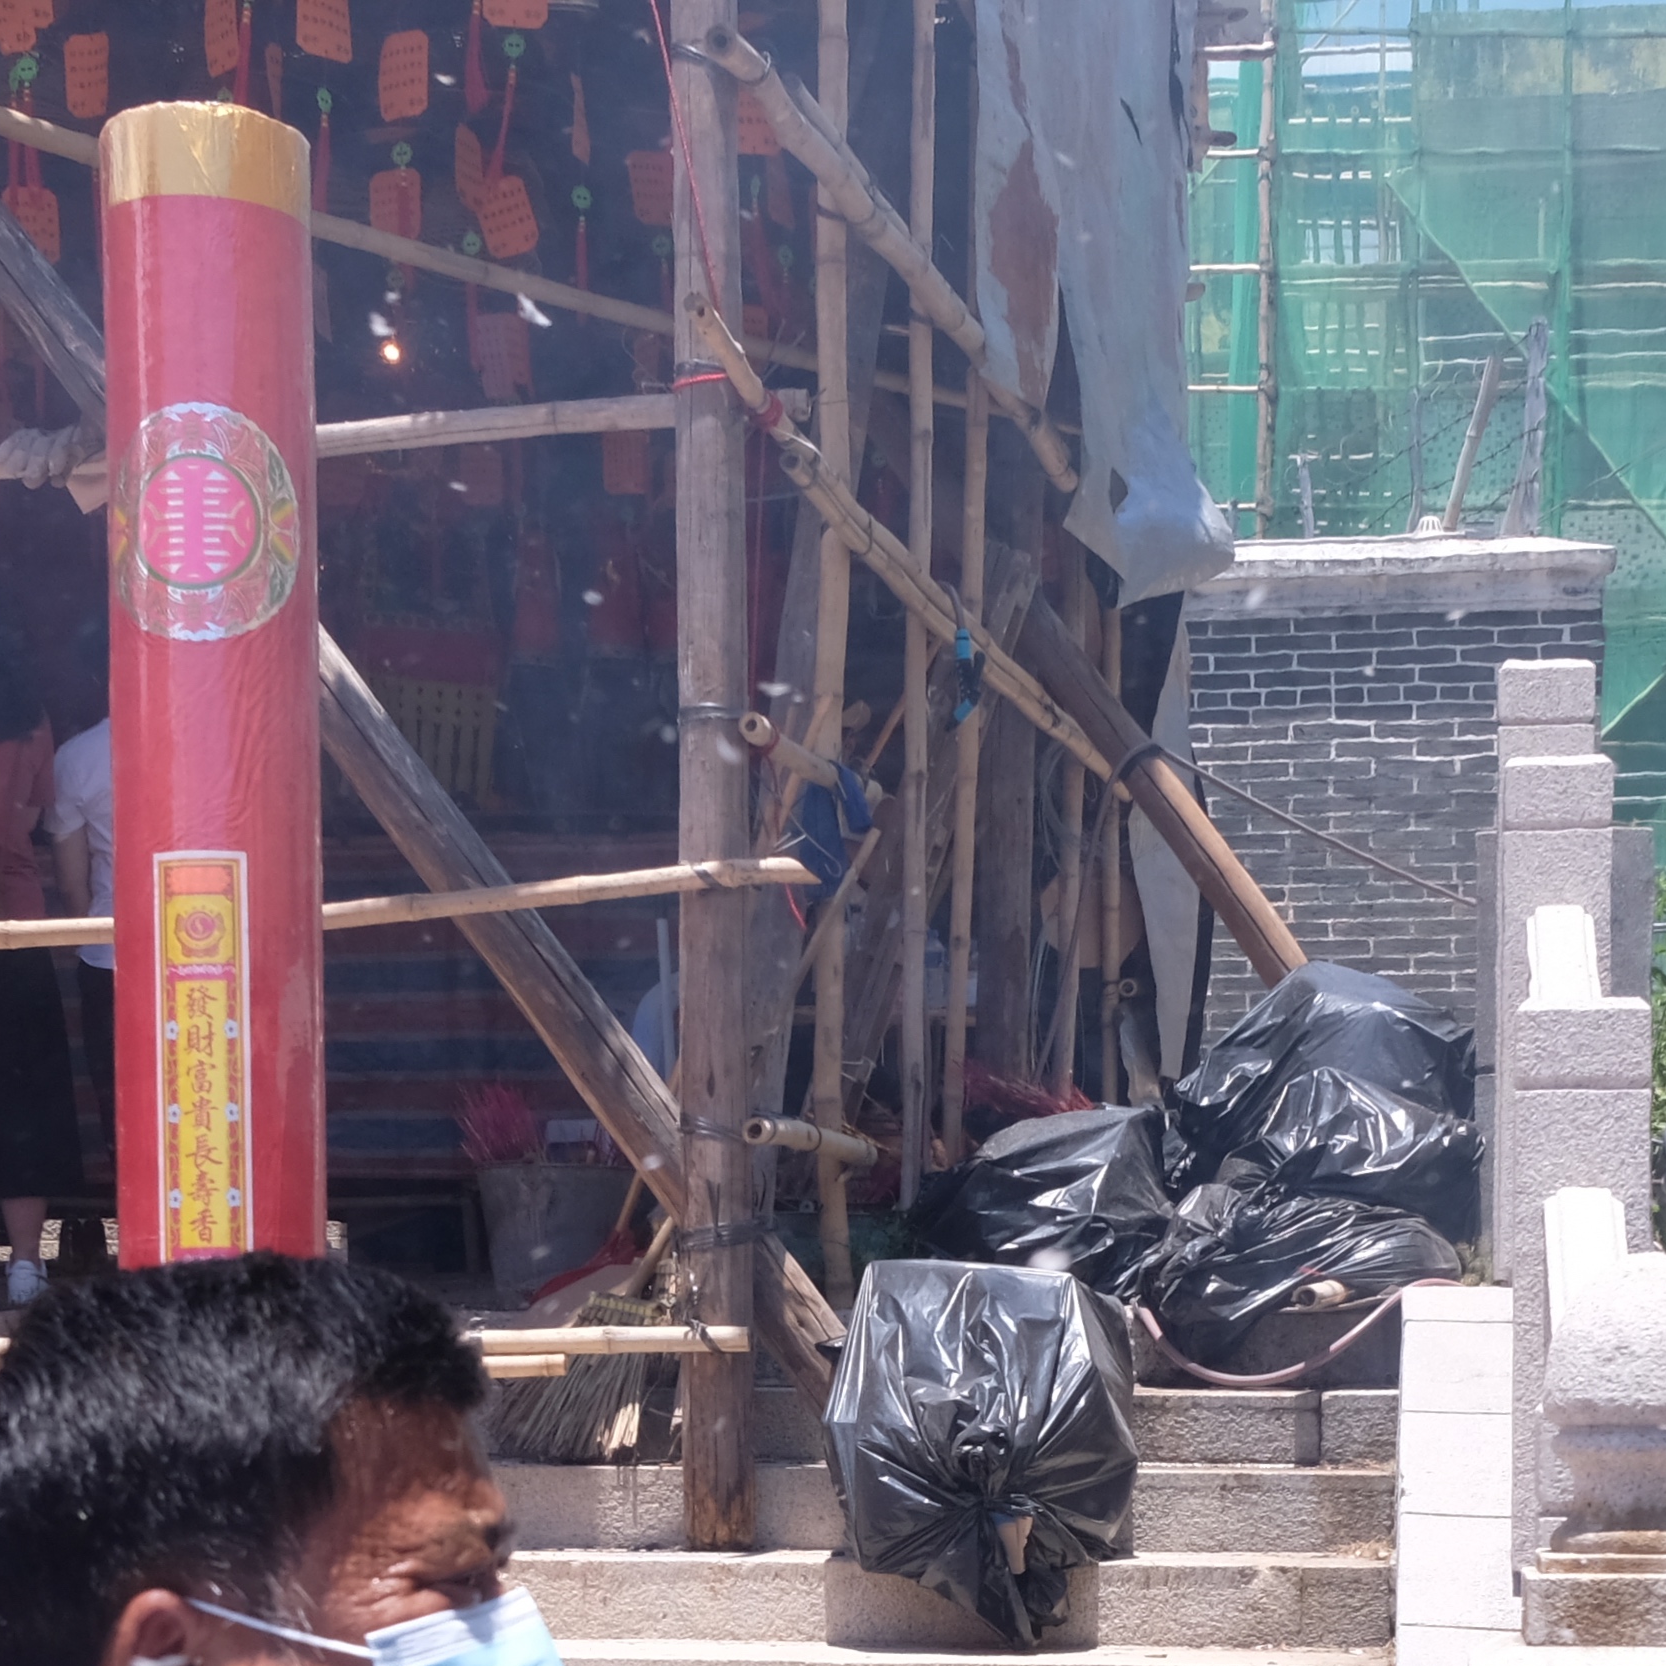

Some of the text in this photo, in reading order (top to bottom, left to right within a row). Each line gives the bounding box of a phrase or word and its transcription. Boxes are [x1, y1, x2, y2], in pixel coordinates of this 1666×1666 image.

[182, 984, 223, 1247] 發財富貴長壽香
